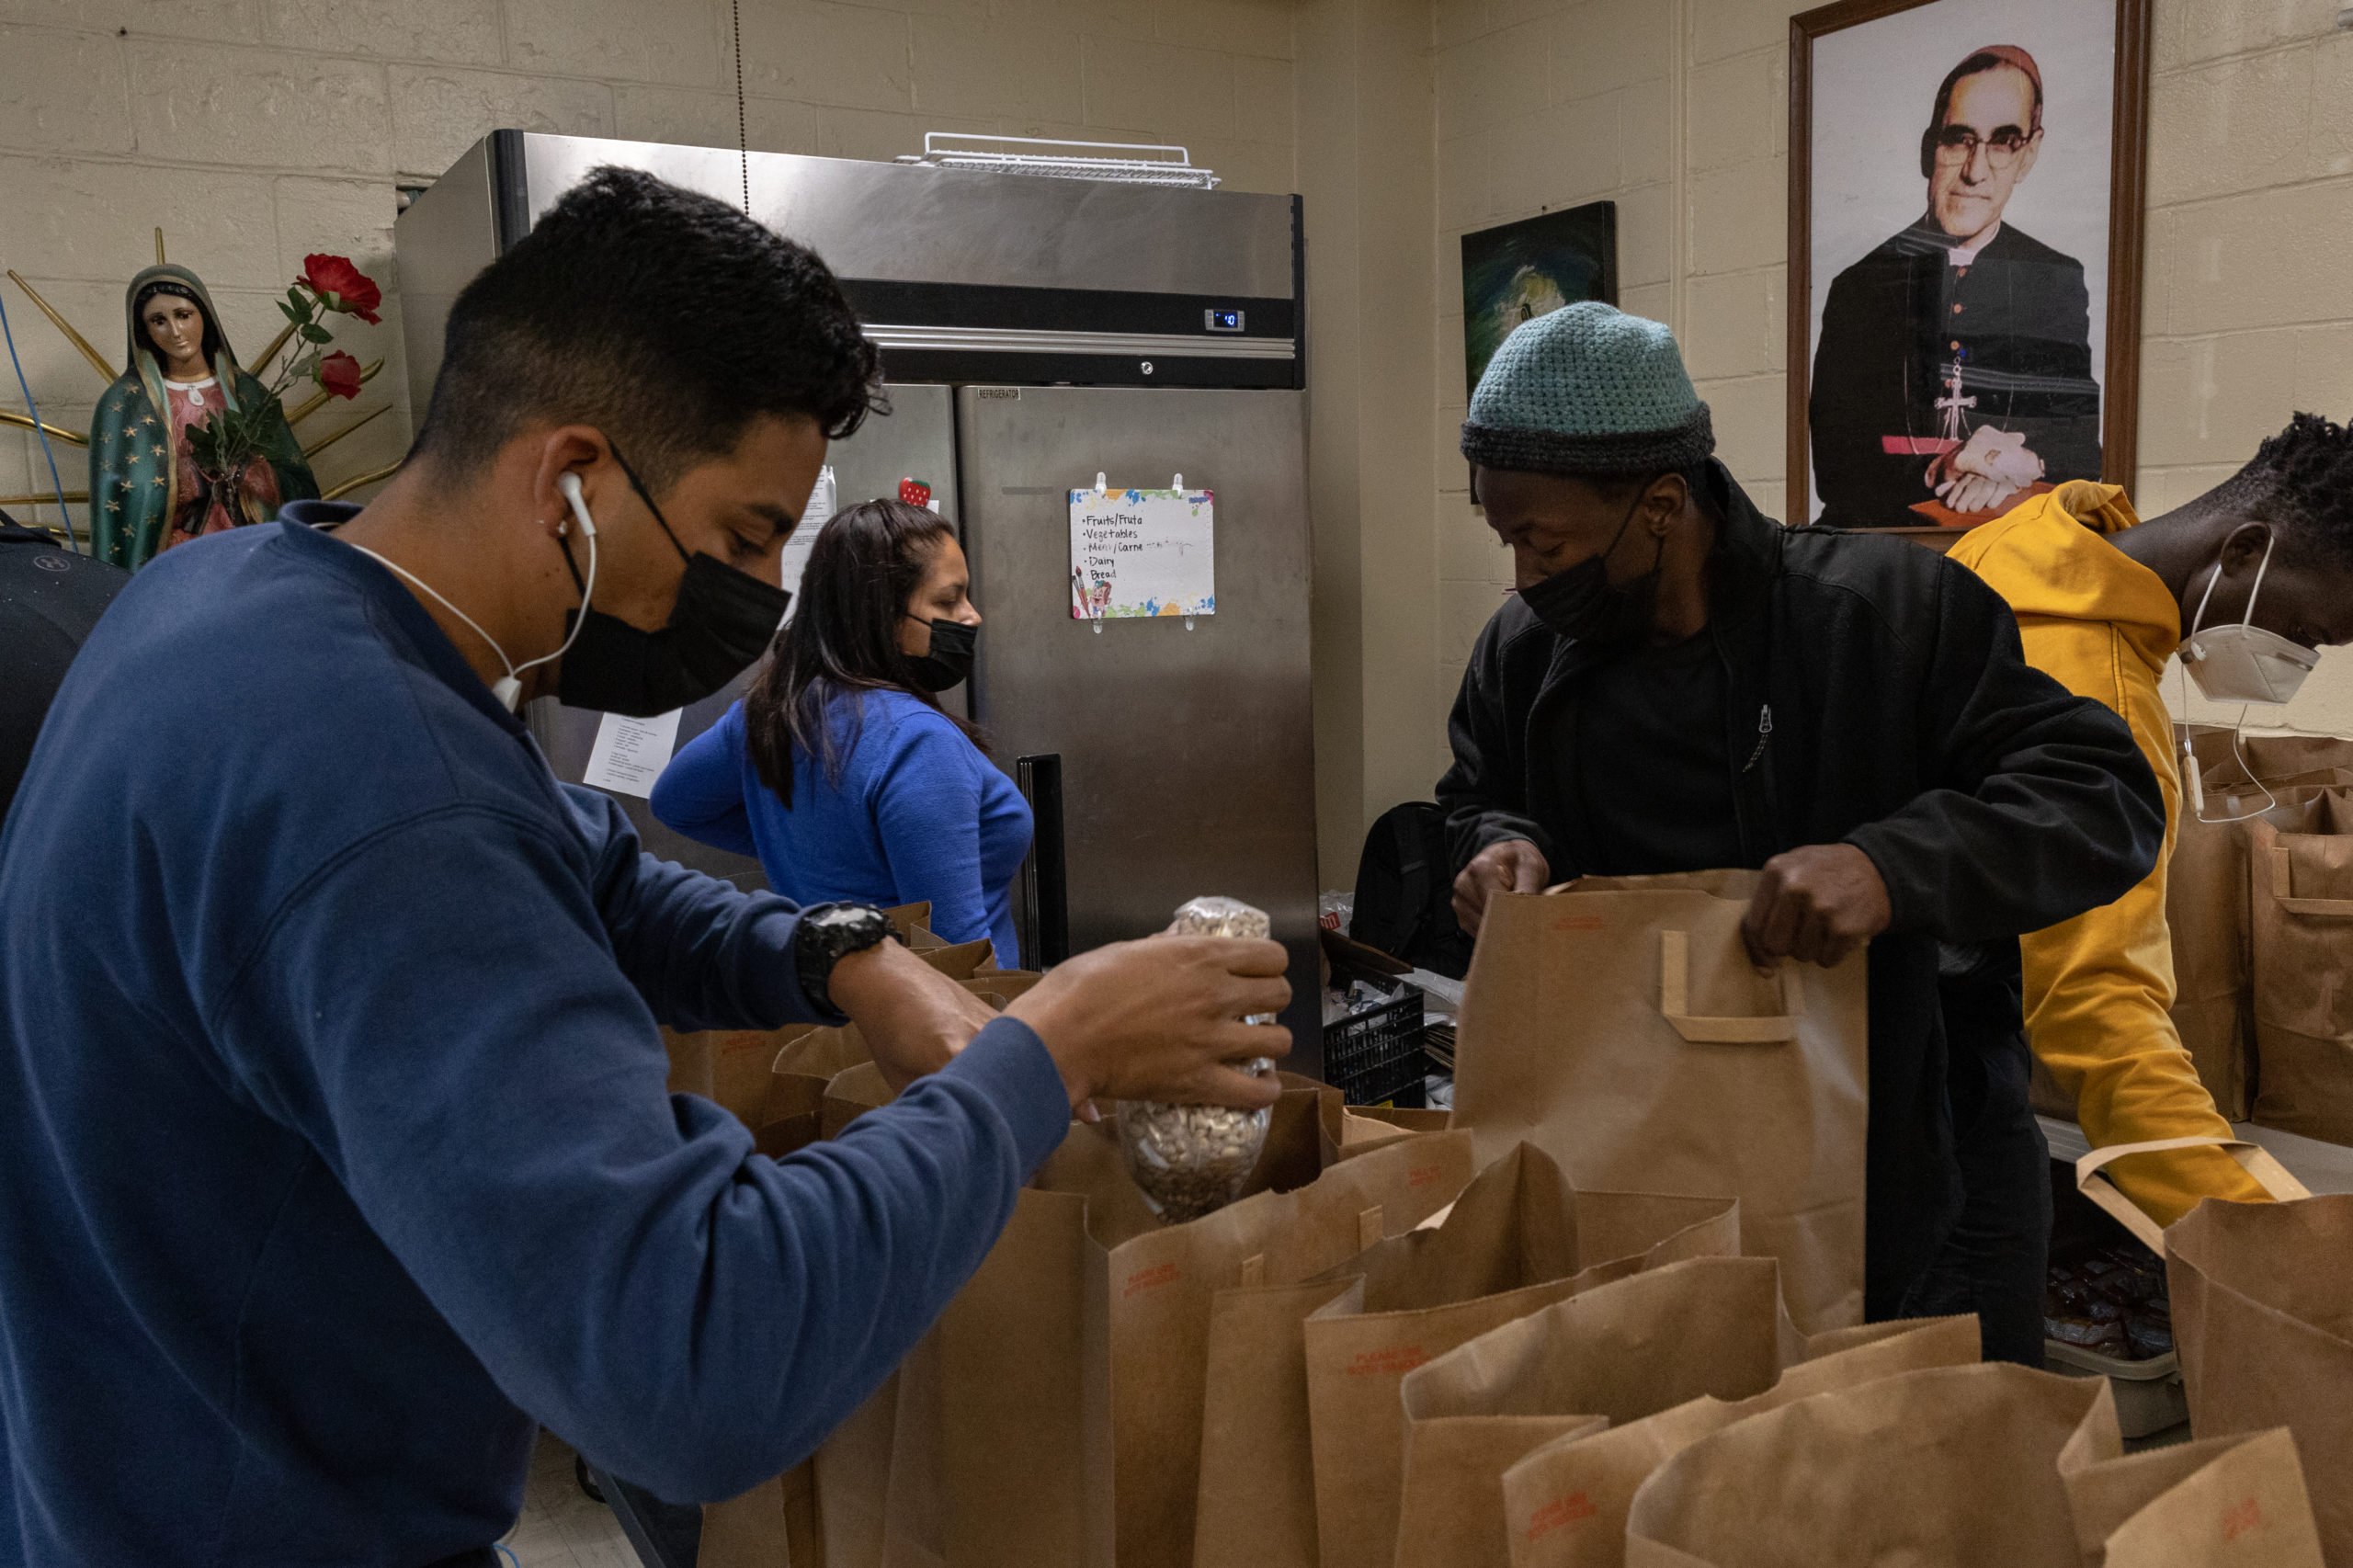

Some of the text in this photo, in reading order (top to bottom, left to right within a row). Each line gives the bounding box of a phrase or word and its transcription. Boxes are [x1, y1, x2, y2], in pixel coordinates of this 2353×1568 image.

[979, 389, 1019, 399] REFRIGERATOR
[1086, 513, 1142, 527] Fruits/Fruta
[1086, 529, 1138, 542] Vegetables
[1089, 556, 1115, 567] Dairy
[1091, 569, 1117, 580] Bread
